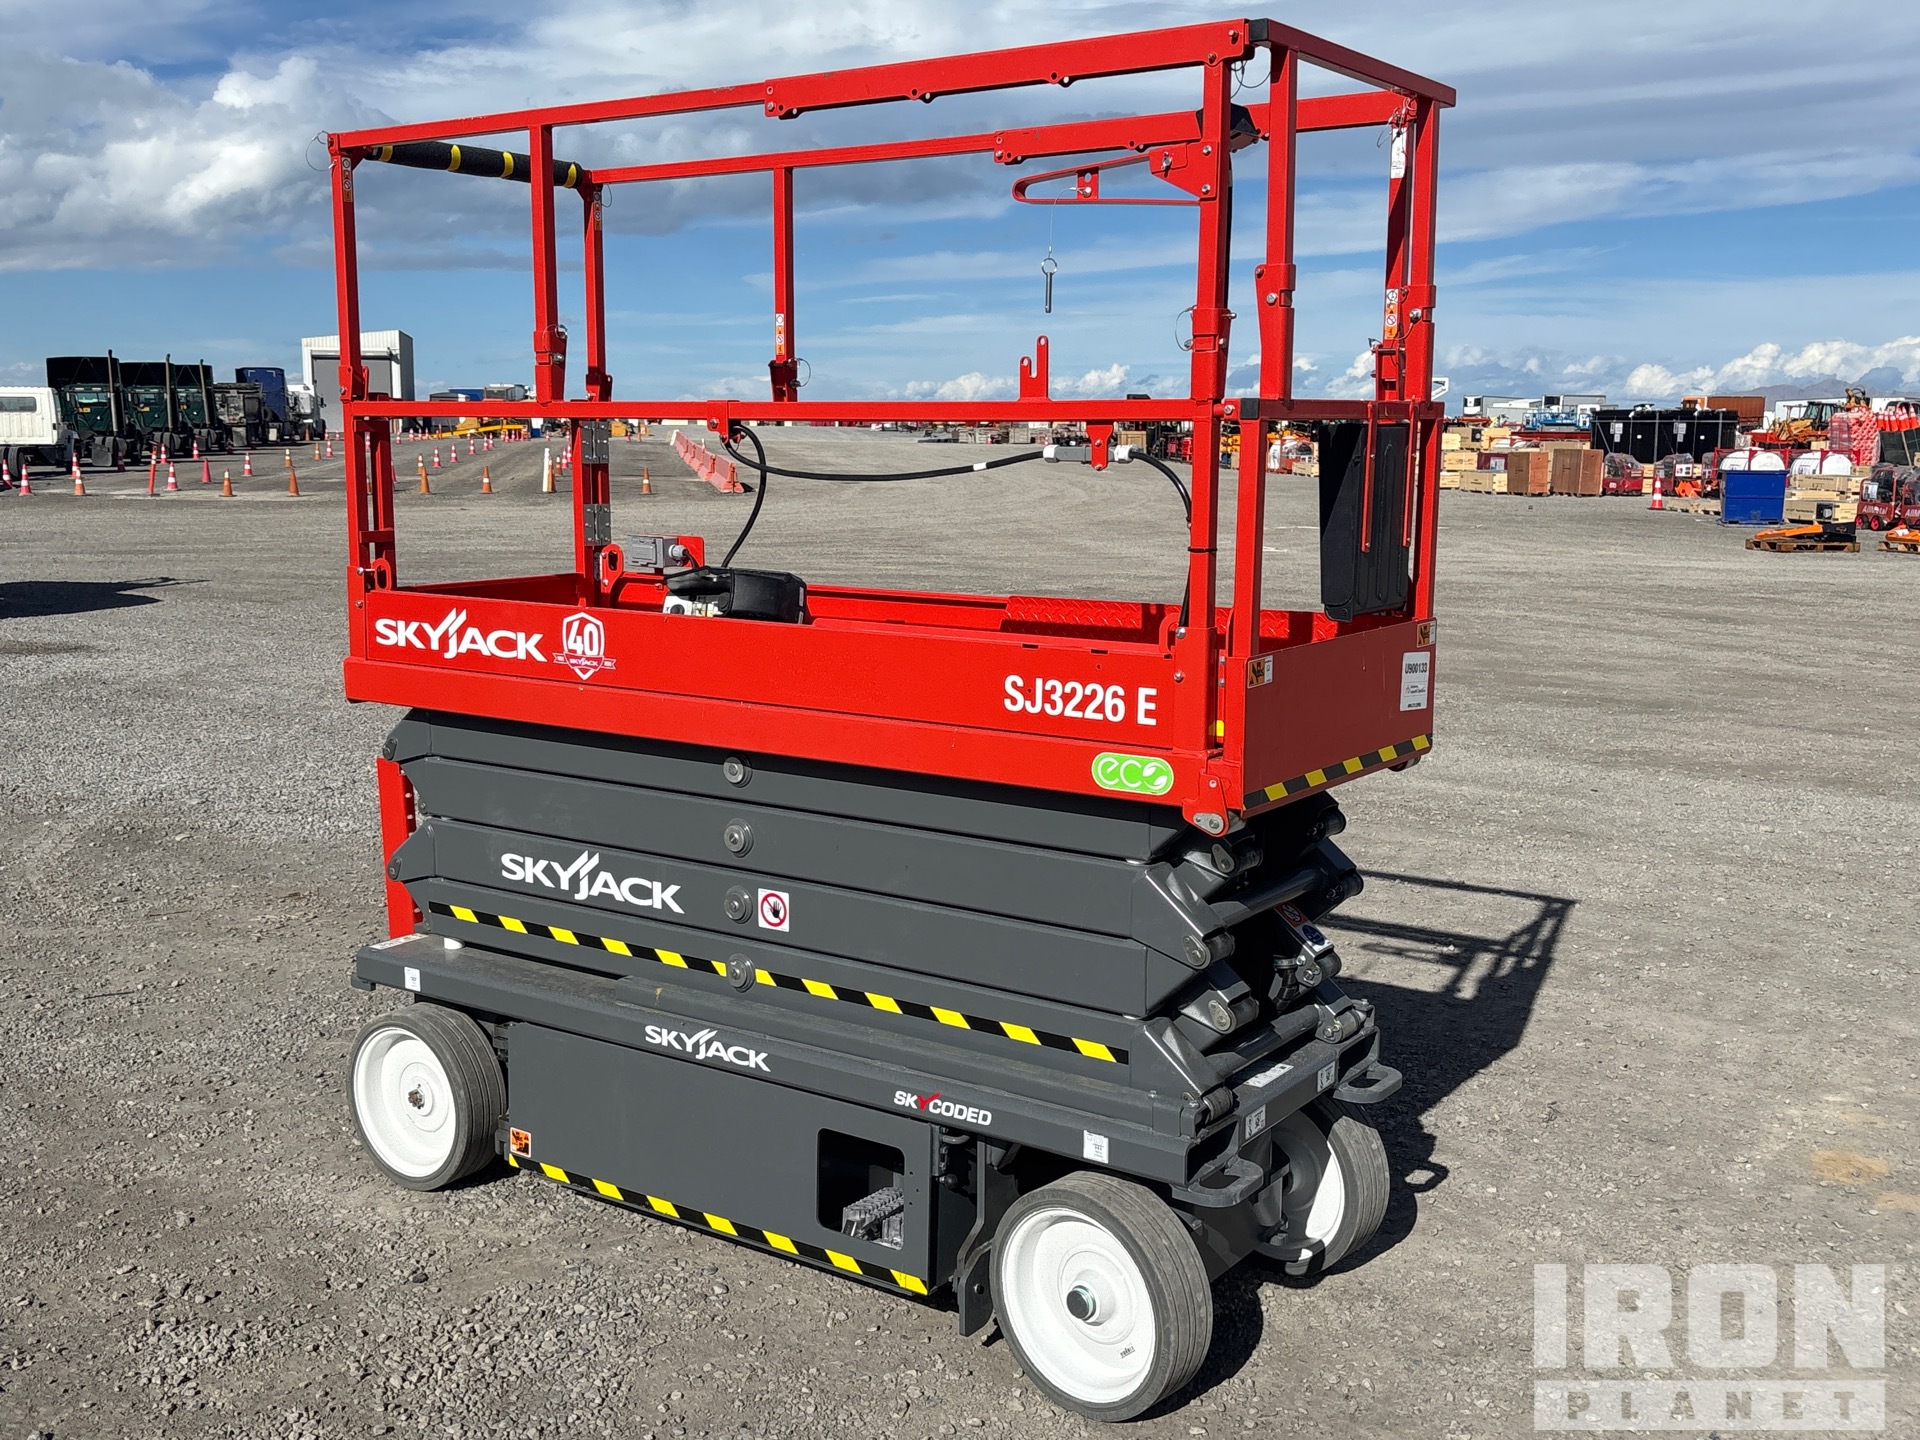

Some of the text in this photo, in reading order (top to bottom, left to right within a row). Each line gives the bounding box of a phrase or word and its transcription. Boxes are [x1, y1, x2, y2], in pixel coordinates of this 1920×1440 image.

[375, 607, 548, 663] SKYJACK
[567, 620, 599, 656] 40
[1405, 662, 1427, 674] U900133
[1003, 674, 1158, 726] SJ3226 E
[1097, 757, 1168, 790] eco
[500, 850, 686, 914] SKYJACK
[644, 1025, 772, 1072] SKYJACK
[893, 1090, 993, 1126] SKYCODED
